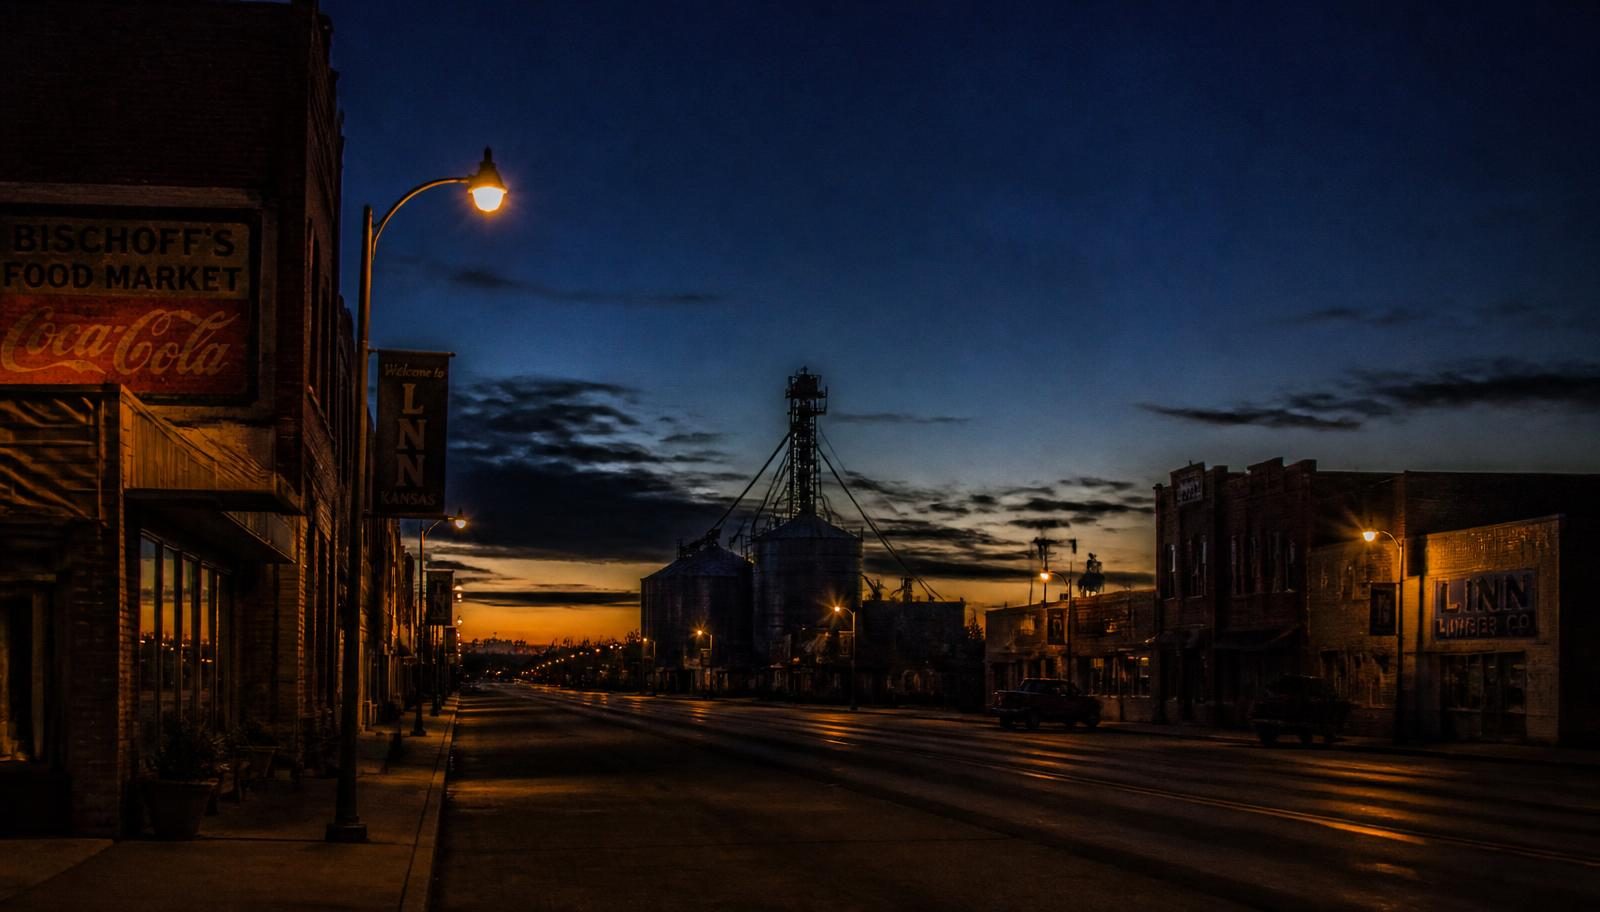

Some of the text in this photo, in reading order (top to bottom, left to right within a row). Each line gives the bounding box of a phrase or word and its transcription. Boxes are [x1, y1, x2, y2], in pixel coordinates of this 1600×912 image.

[14, 224, 235, 256] BISCHOFF'S
[4, 262, 242, 292] FOOD MARKET
[384, 362, 432, 377] Welcome
[380, 490, 436, 506] KANSAS
[1438, 574, 1532, 614] LINN
